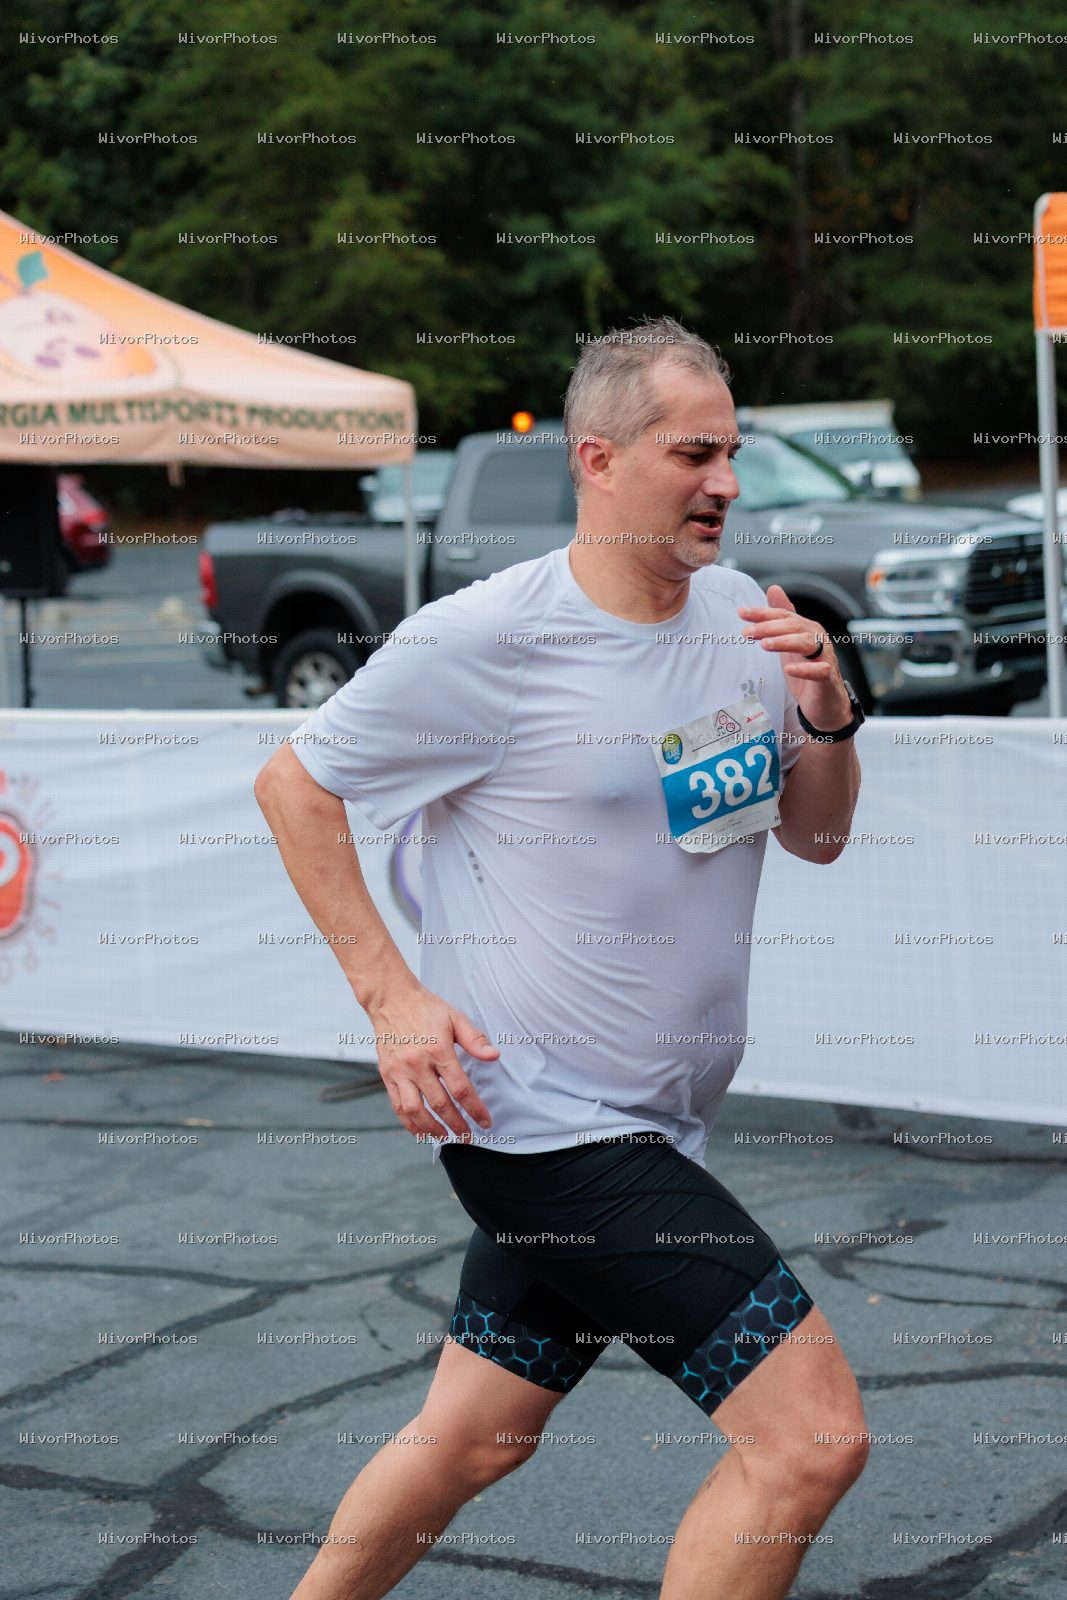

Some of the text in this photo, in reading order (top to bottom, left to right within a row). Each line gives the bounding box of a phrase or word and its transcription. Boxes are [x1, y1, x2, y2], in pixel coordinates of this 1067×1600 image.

[67, 399, 239, 427] MULTISPORTS
[246, 406, 405, 431] PRODUCTIONS
[688, 744, 774, 819] 382
